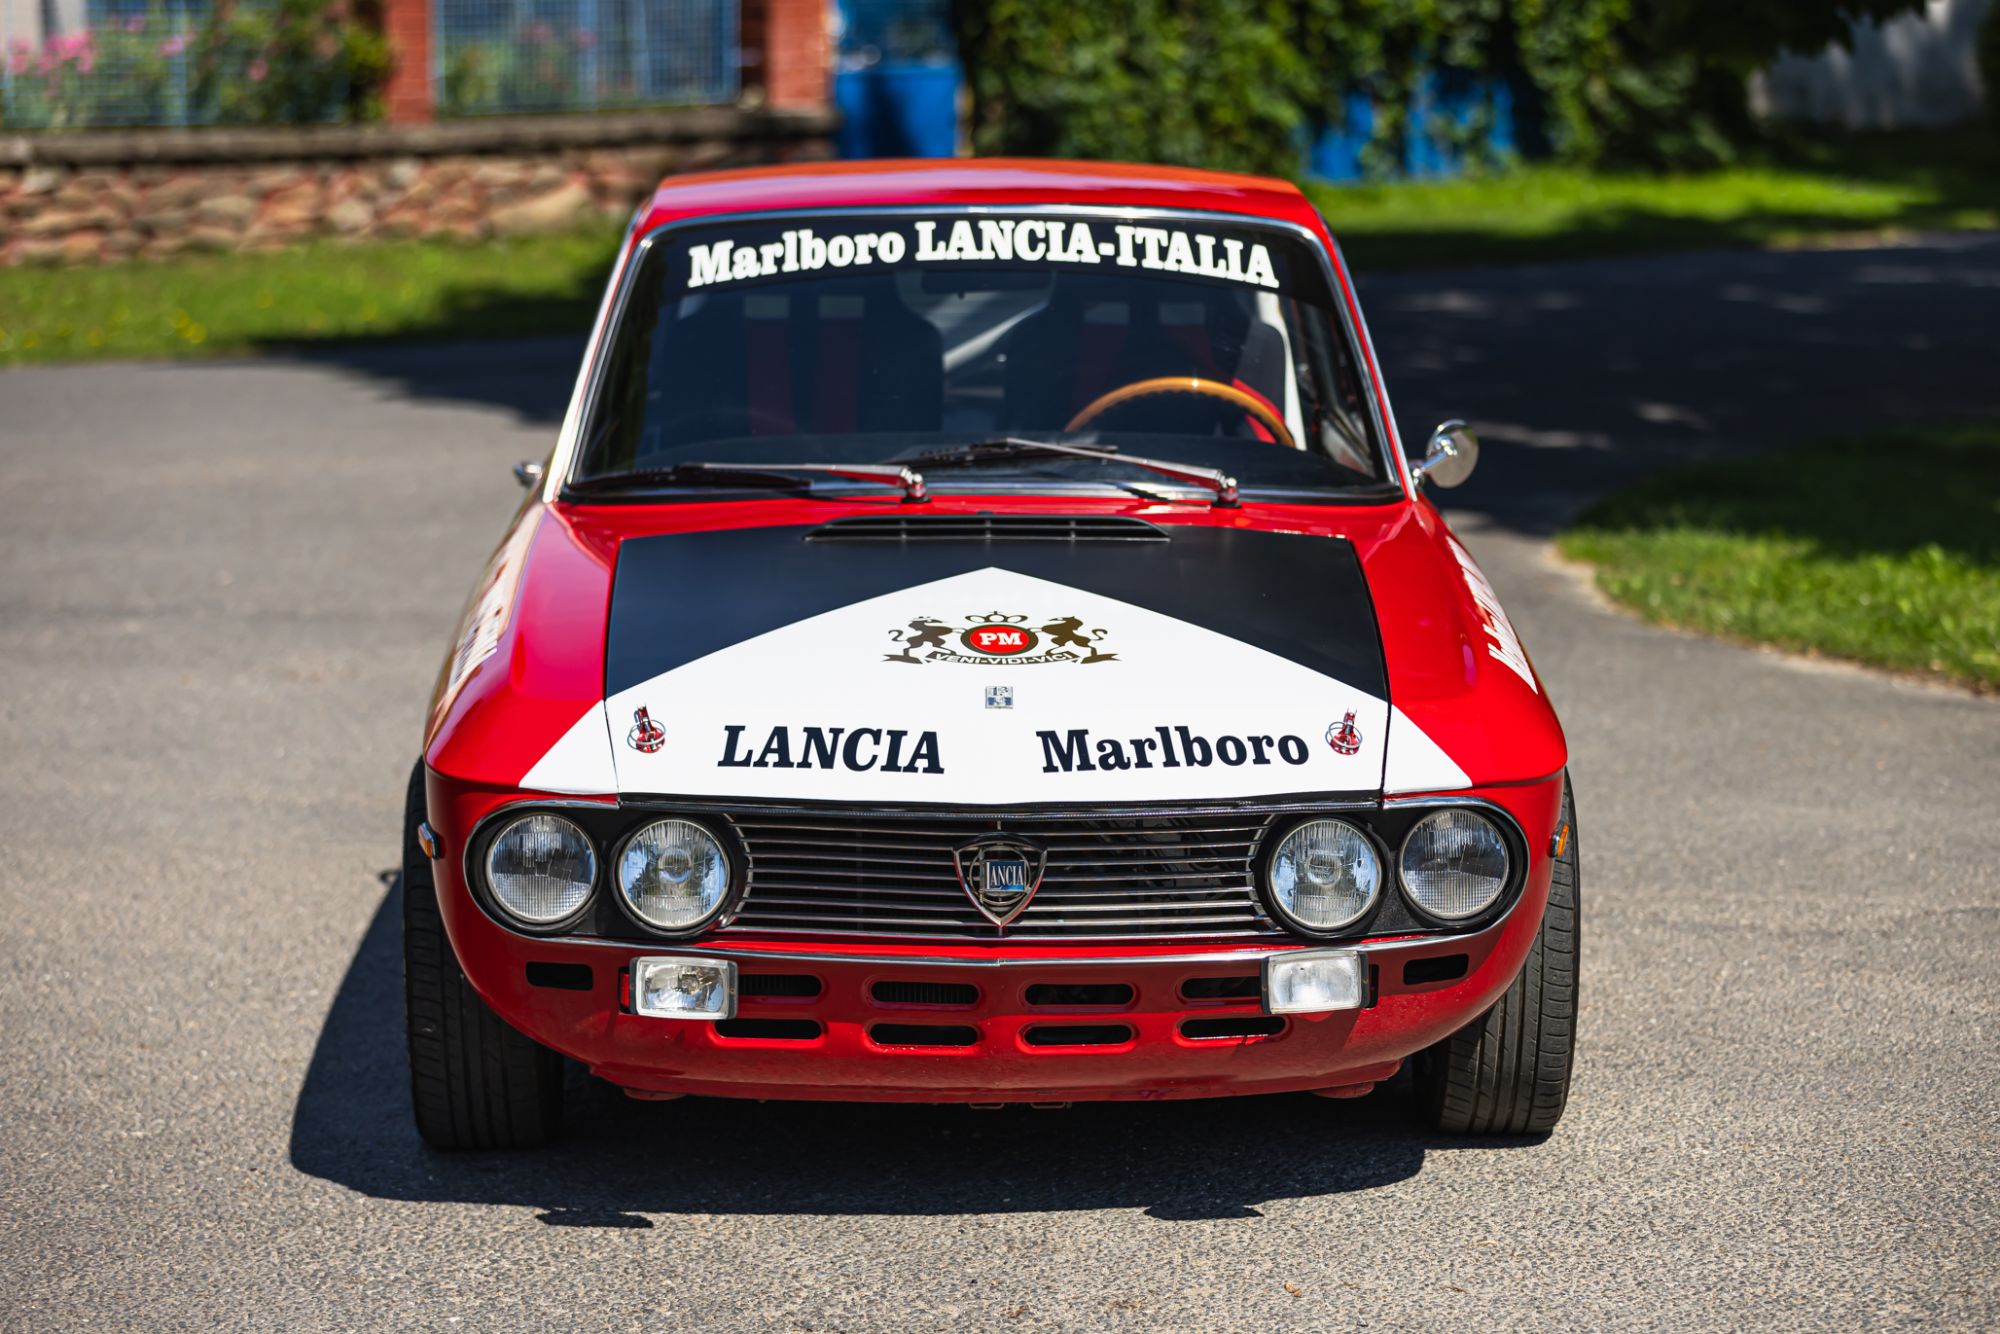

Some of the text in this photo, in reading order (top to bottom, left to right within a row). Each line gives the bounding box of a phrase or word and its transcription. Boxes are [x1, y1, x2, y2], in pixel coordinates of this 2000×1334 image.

[688, 220, 1280, 288] Marlboro LANCIA-ITALIA
[979, 633, 1023, 646] PM
[934, 652, 1074, 665] VENI-VIDI-VICI
[718, 725, 944, 774] LANCIA
[1036, 726, 1309, 773] Marlboro
[986, 862, 1024, 890] LANCIA
